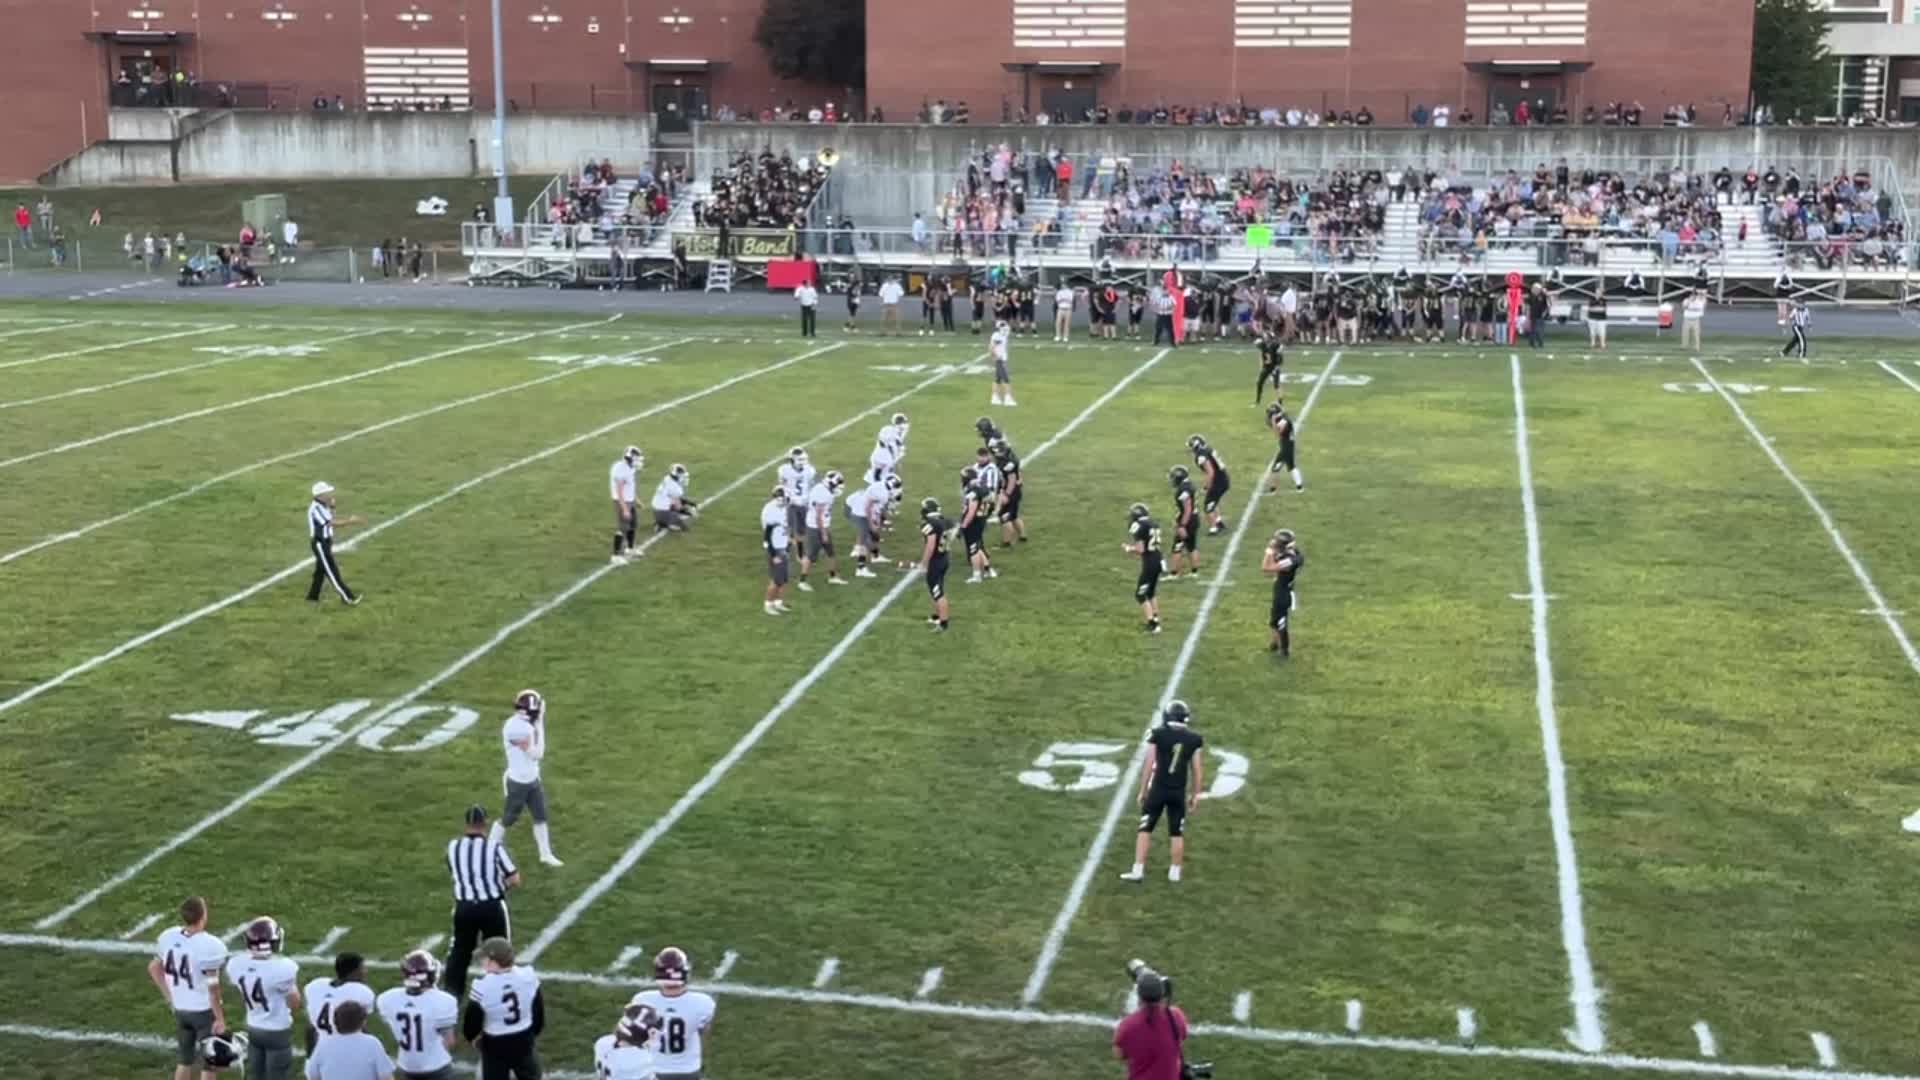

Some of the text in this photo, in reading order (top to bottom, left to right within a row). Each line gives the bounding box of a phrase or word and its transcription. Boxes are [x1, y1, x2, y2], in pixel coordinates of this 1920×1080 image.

[742, 235, 791, 255] Band
[1168, 742, 1183, 774] 1
[165, 949, 194, 990] 44
[238, 975, 270, 1014] 14
[501, 991, 521, 1026] 3
[396, 1010, 424, 1052] 31
